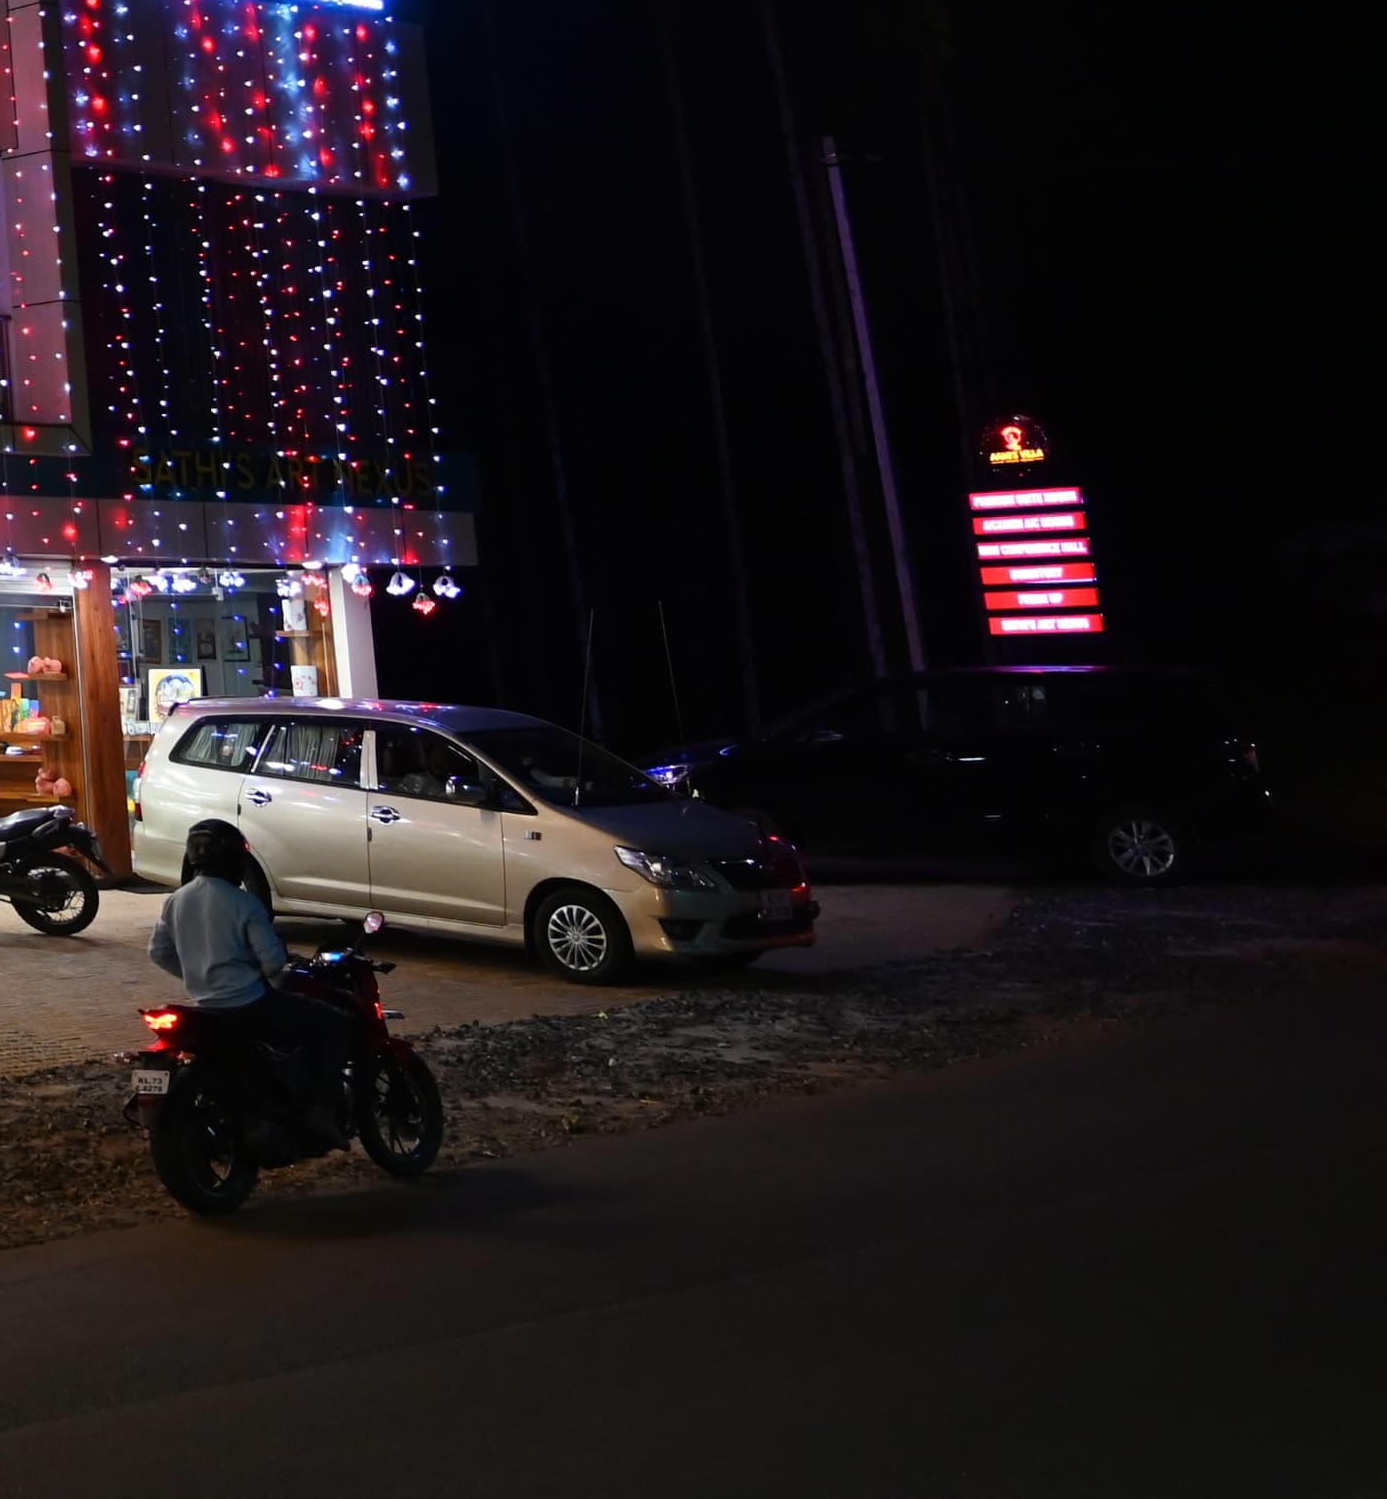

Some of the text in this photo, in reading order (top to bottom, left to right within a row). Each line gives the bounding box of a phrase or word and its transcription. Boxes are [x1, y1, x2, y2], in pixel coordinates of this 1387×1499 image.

[1019, 448, 1045, 460] VILLA
[265, 450, 322, 489] ART
[334, 458, 434, 496] NEXUS
